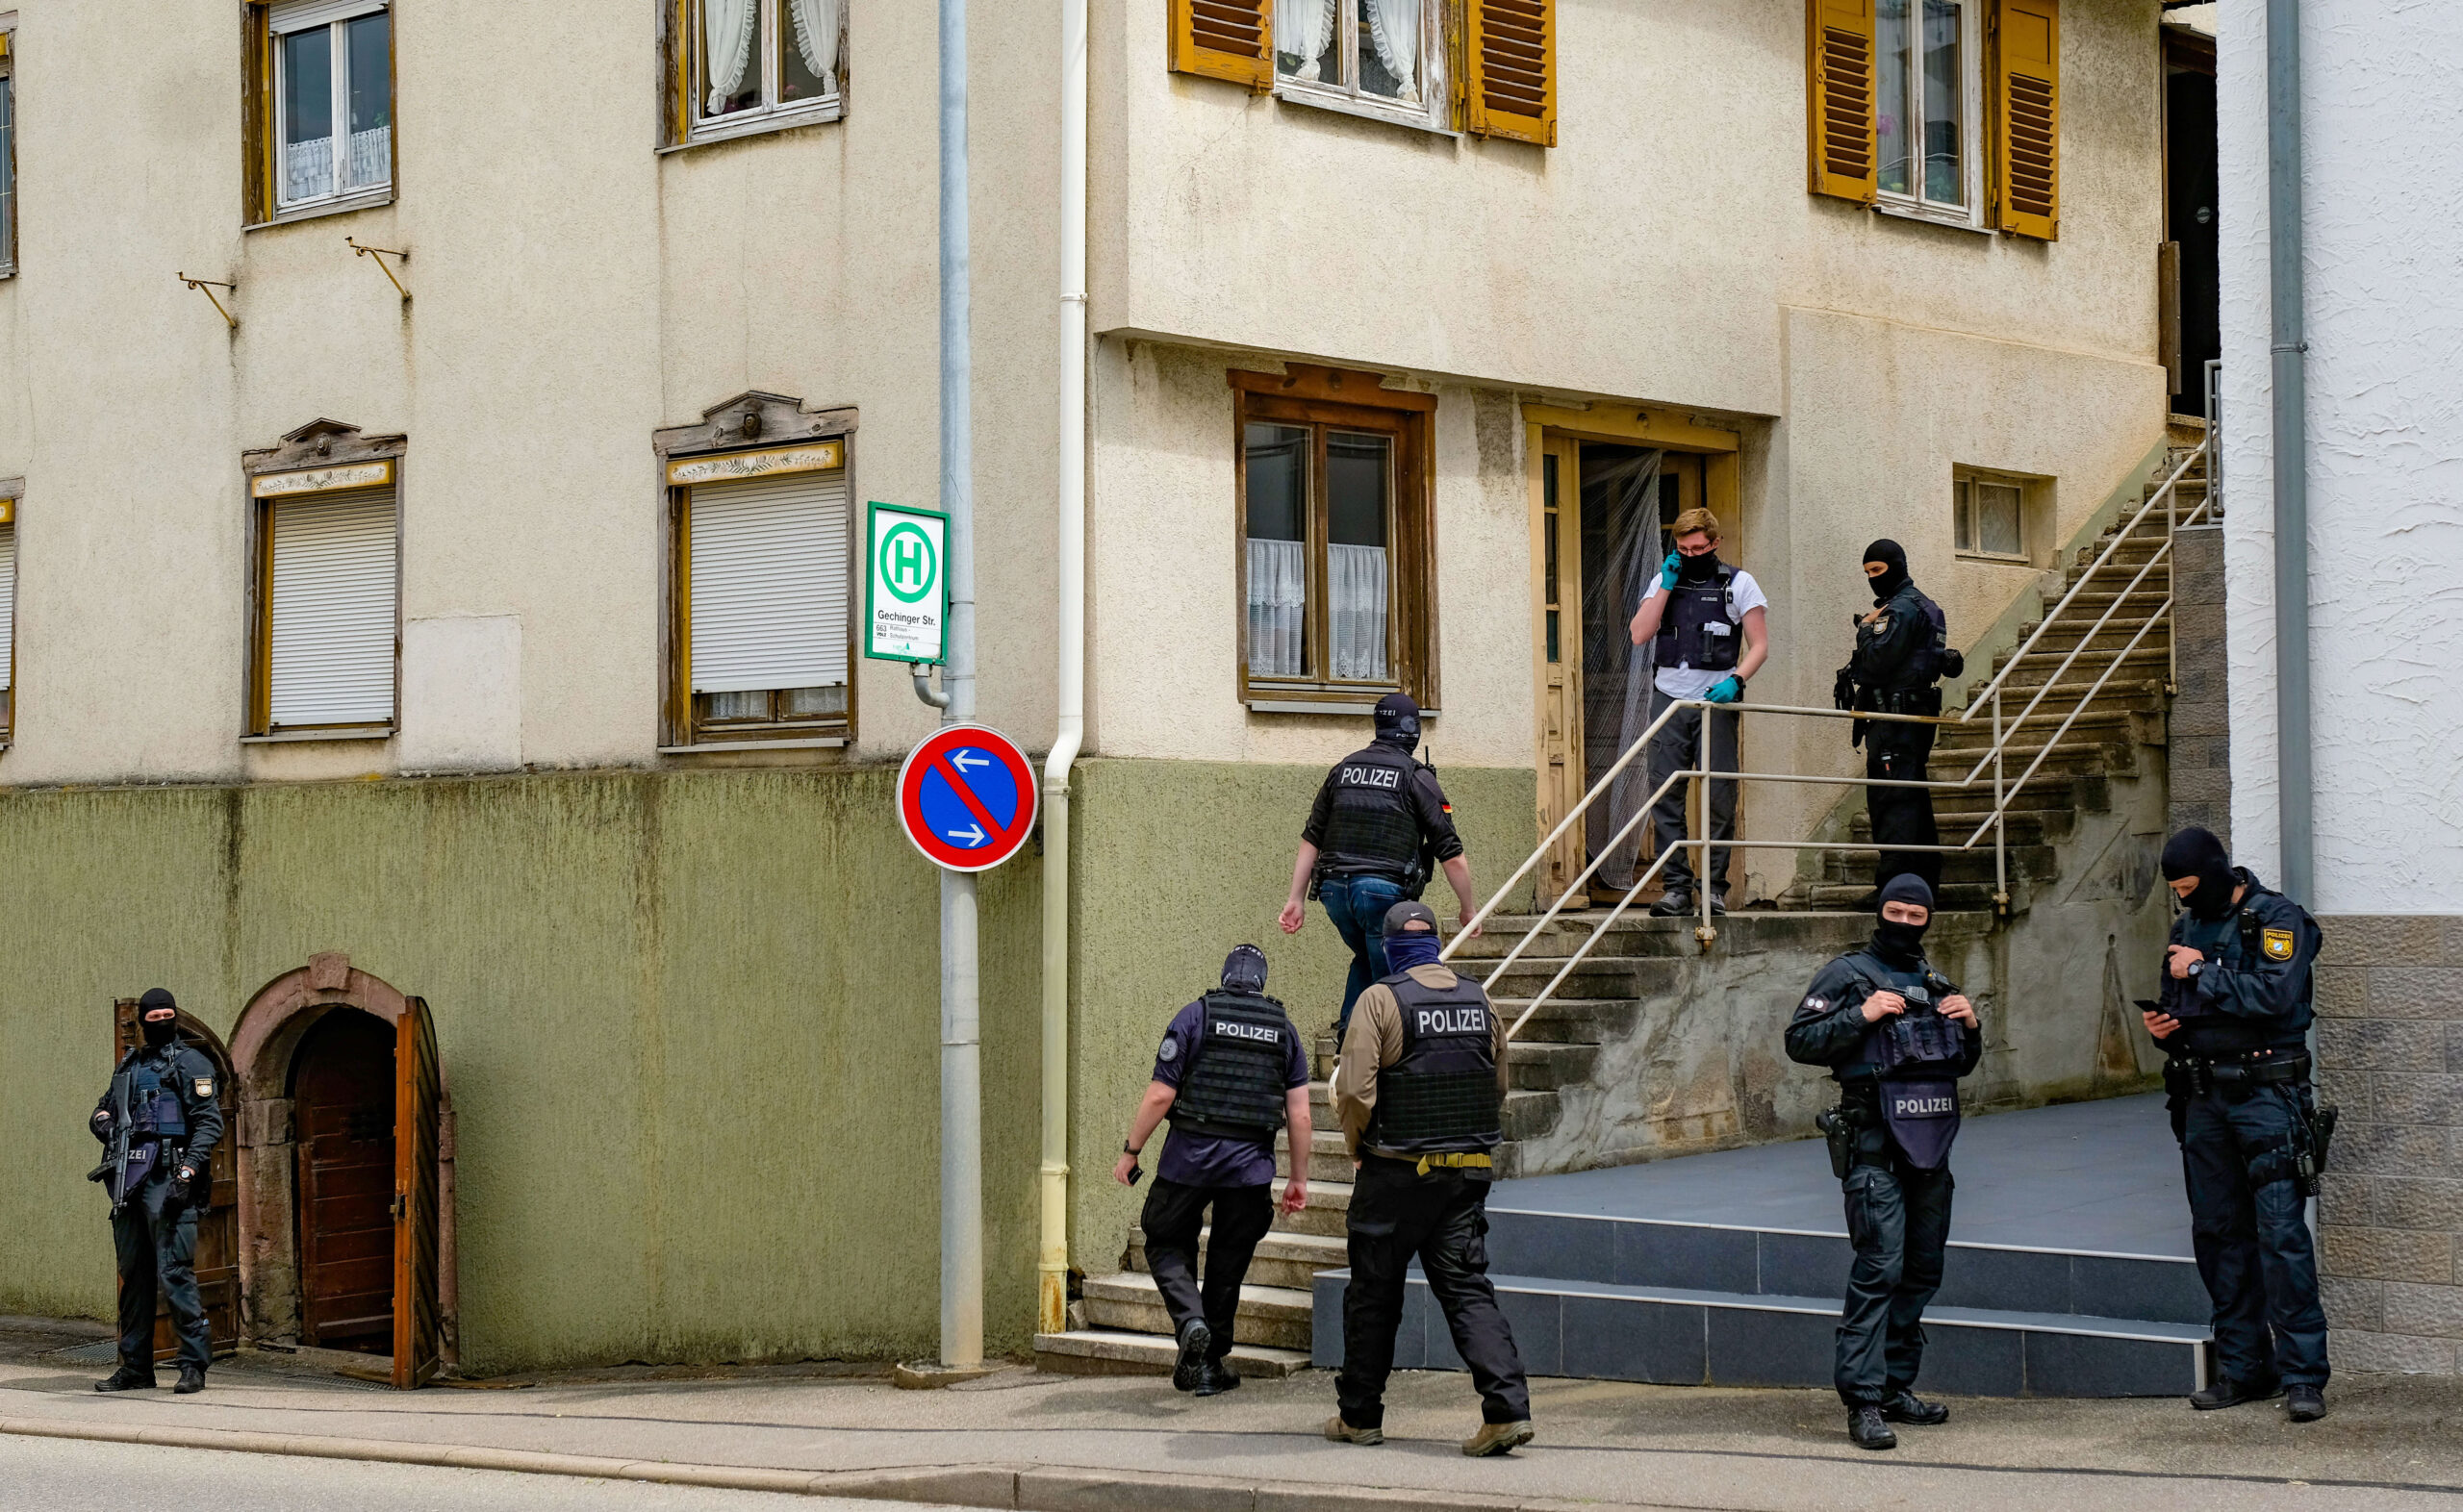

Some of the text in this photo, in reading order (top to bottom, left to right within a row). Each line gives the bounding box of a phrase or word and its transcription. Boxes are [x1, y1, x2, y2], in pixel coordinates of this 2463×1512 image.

[895, 540, 922, 586] H
[877, 610, 936, 626] Gechinger Str.
[1341, 768, 1399, 788] POLIZEI
[1418, 1009, 1486, 1034] POLIZEI
[1216, 1021, 1279, 1044] POLIZEI
[1895, 1097, 1952, 1115] POLIZEI
